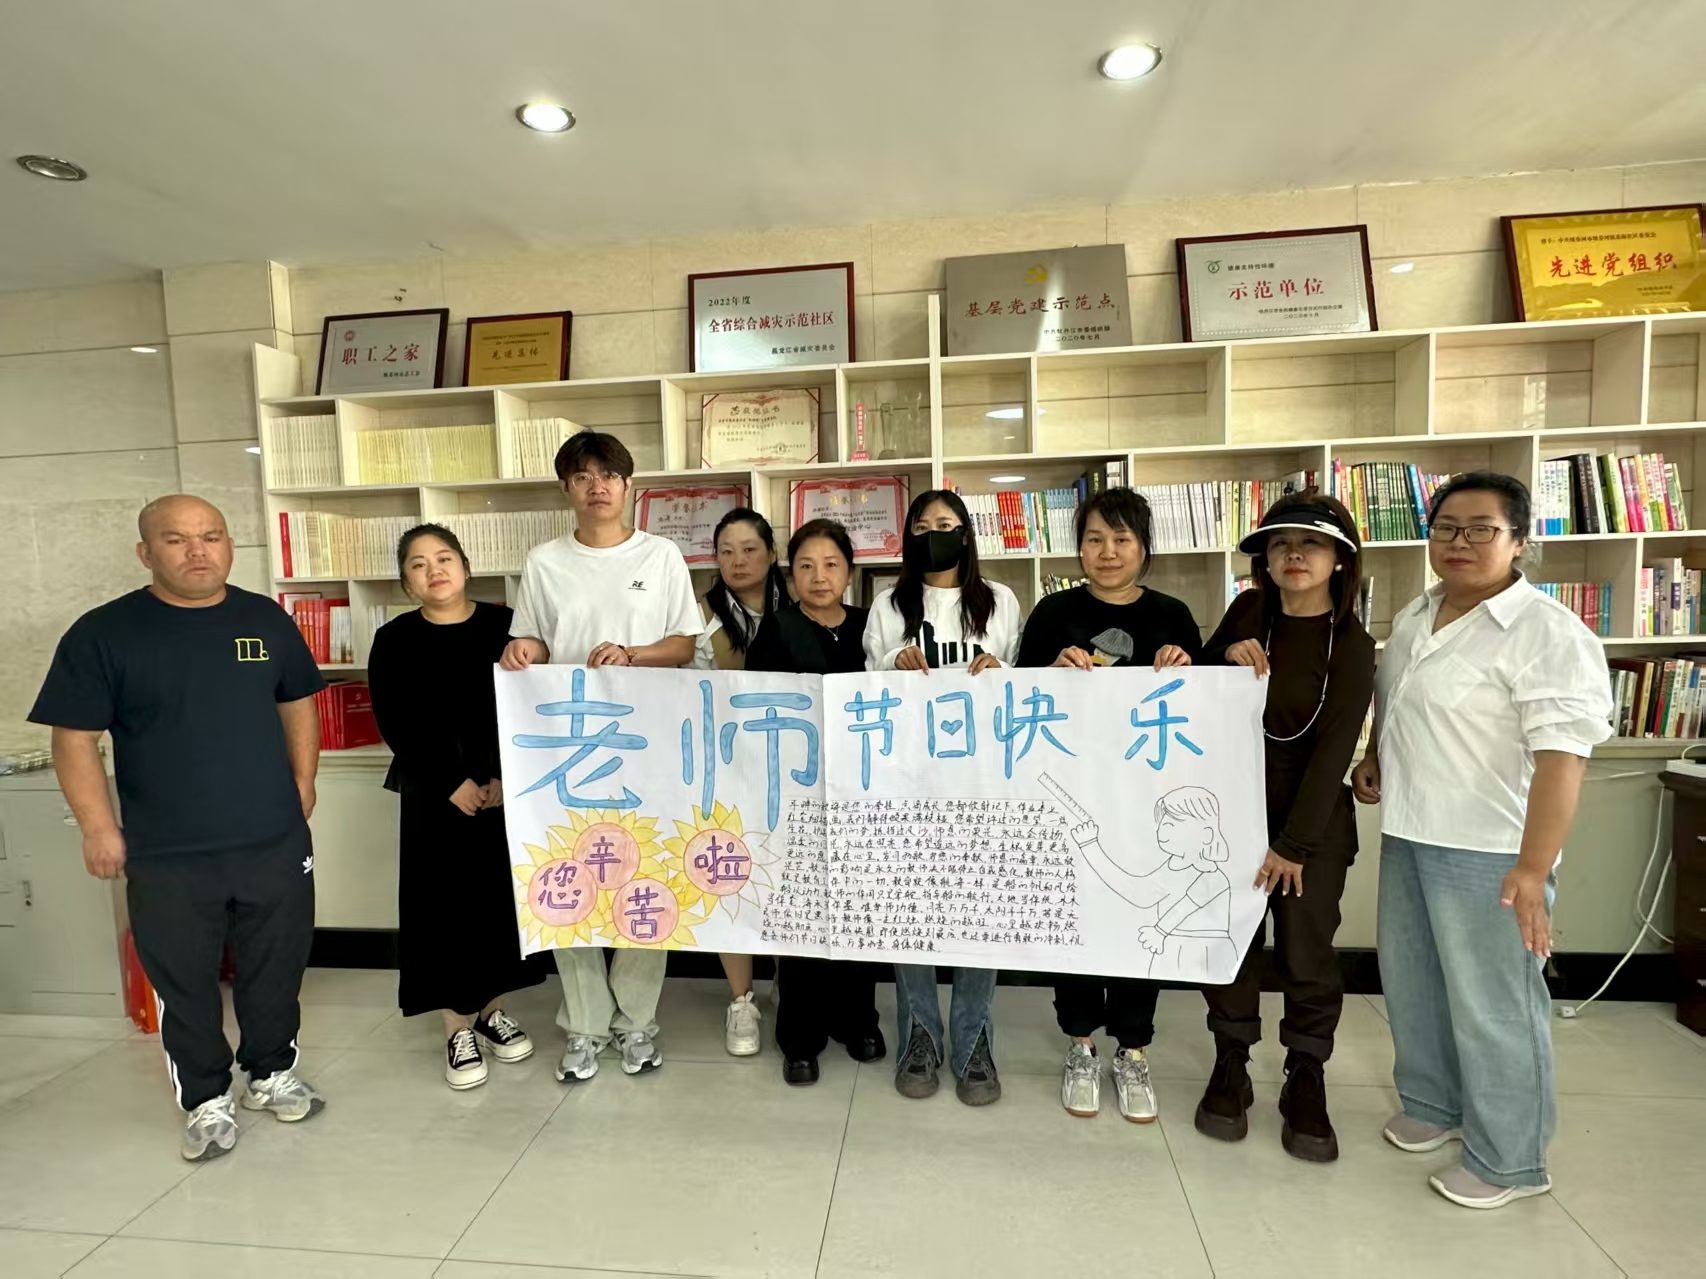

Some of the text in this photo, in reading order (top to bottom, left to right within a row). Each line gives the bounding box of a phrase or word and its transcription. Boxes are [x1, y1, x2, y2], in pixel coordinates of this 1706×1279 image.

[1549, 251, 1678, 278] 先进党组织
[1228, 278, 1324, 300] 示范单位
[708, 295, 751, 307] 2022年度
[965, 292, 1116, 318] 基层党建示范点
[708, 311, 834, 333] 全省综合减灾示范社区
[341, 343, 420, 365] 职工之家
[513, 668, 1204, 832] 老师节日快乐
